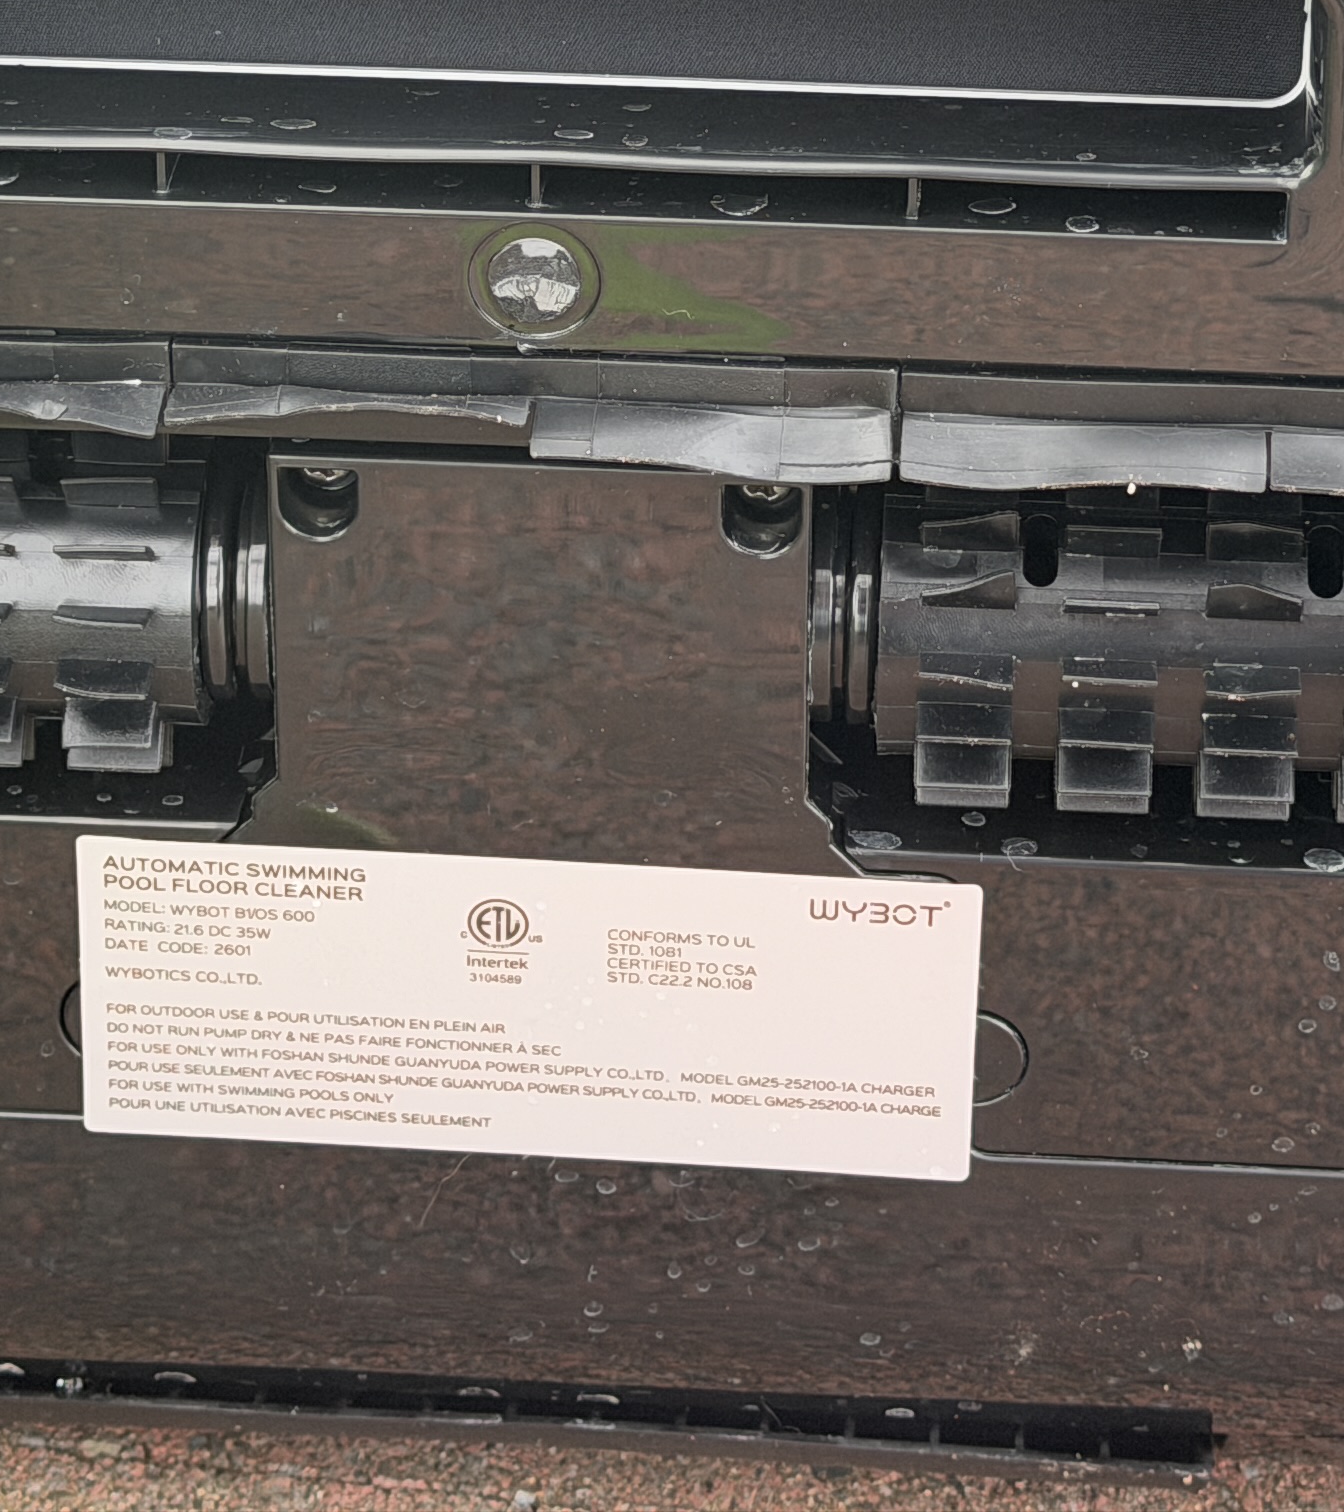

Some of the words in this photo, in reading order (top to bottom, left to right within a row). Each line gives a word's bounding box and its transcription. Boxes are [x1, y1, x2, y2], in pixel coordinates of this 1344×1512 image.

[102, 854, 240, 877] AUTOMATIC
[245, 862, 367, 883] SWIMMING
[103, 873, 167, 892] POOL
[171, 877, 249, 896] FLOOR
[254, 881, 364, 902] CLEANER
[103, 898, 166, 915] MODEL:
[169, 903, 231, 919] WYBOT
[282, 909, 316, 923] 600
[104, 917, 171, 934] RATING:
[173, 923, 205, 937] 21.6
[208, 924, 232, 938] DC
[235, 926, 272, 940] 35W
[476, 906, 521, 943] ETL
[104, 936, 149, 953] DATE
[157, 940, 209, 955] CODE:
[213, 943, 252, 957] 2601
[607, 928, 703, 946] CONFORMS
[706, 933, 730, 948] TO
[733, 935, 756, 949] UL
[607, 942, 645, 957] STD.
[648, 945, 682, 959] 1081
[104, 965, 192, 982] WYBOTICS
[466, 954, 530, 970] Intertek
[606, 956, 692, 974] CERTIFIED
[695, 961, 719, 975] TO
[722, 963, 758, 977] CSA
[469, 972, 523, 985] 3104589
[606, 970, 644, 985] STD.
[647, 973, 693, 988] C22.2
[696, 976, 753, 991] NO.108
[105, 1002, 138, 1015] FOR
[140, 1004, 216, 1019] OUTDOOR
[218, 1008, 250, 1022] USE
[253, 1010, 264, 1022] &
[267, 1010, 311, 1024] POUR
[312, 1013, 406, 1029] UTILISATION
[408, 1018, 430, 1031] EN
[433, 1019, 477, 1033] PLEIN
[479, 1022, 507, 1035] AIR
[106, 1021, 130, 1034] DO
[132, 1023, 164, 1036] NOT
[167, 1024, 200, 1038] RUN
[203, 1026, 248, 1039] PUMP
[250, 1029, 283, 1041] DRY
[285, 1030, 297, 1043] &
[299, 1031, 320, 1044] NE
[323, 1032, 356, 1046] PAS
[358, 1034, 402, 1049] FAIRE
[405, 1037, 514, 1054] FONCTIONNER
[531, 1044, 562, 1057] SEC
[107, 1040, 139, 1053] FOR
[140, 1042, 172, 1055] USE
[175, 1044, 217, 1057] ONLY
[219, 1046, 259, 1059] WITH
[261, 1048, 325, 1063] FOSHAN
[327, 1051, 391, 1067] SHUNDE
[394, 1055, 482, 1071] GUANYUDA
[484, 1060, 541, 1075] POWER
[543, 1063, 604, 1078] SUPPLY
[680, 1072, 734, 1086] MODEL
[736, 1075, 859, 1094] GM25-252100-1A
[860, 1082, 936, 1098] CHARGER
[107, 1059, 149, 1073] POUR
[151, 1062, 181, 1075] USE
[183, 1063, 271, 1079] SEULEMENT
[272, 1068, 313, 1081] AVEC
[315, 1070, 376, 1085] FOSHAN
[378, 1073, 439, 1088] SHUNDE
[440, 1077, 525, 1093] GUANYUDA
[526, 1081, 581, 1096] POWER
[582, 1085, 640, 1099] SUPPLY
[710, 1093, 763, 1107] MODEL
[763, 1095, 879, 1113] GM25-252100-1A
[879, 1102, 942, 1117] CHARGE
[108, 1078, 140, 1091] FOR
[142, 1080, 173, 1093] USE
[176, 1082, 215, 1094] WITH
[217, 1084, 296, 1099] SWIMMING
[299, 1088, 351, 1102] POOLS
[352, 1091, 395, 1105] ONLY
[108, 1096, 152, 1110] POUR
[154, 1099, 186, 1113] UNE
[189, 1101, 282, 1117] UTILISATION
[284, 1106, 326, 1120] AVEC
[329, 1108, 398, 1124] PISCINES
[400, 1112, 492, 1128] SEULEMENT
